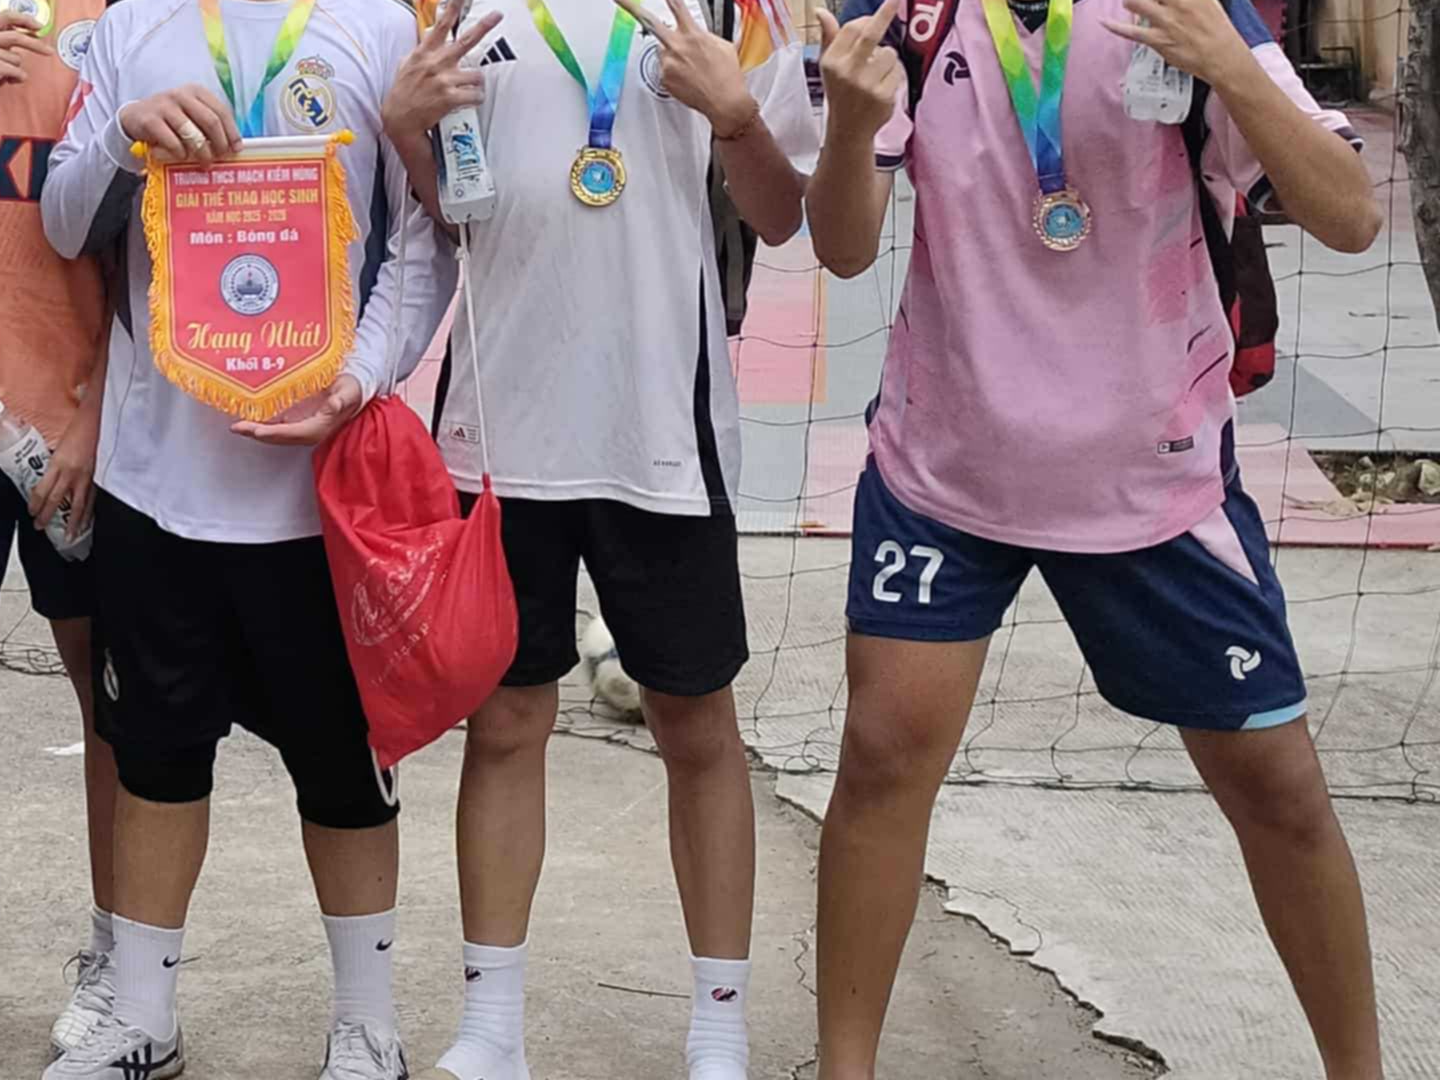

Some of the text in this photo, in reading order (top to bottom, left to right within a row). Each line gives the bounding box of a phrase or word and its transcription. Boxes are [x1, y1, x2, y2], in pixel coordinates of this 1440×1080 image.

[227, 190, 258, 206] THAO
[288, 188, 319, 204] SINH
[189, 231, 224, 244] Môn
[236, 229, 276, 243] Bóng
[279, 227, 299, 241] đá
[186, 320, 321, 355] Hạng Nhất
[261, 356, 286, 371] 8-9
[872, 539, 944, 604] 27
